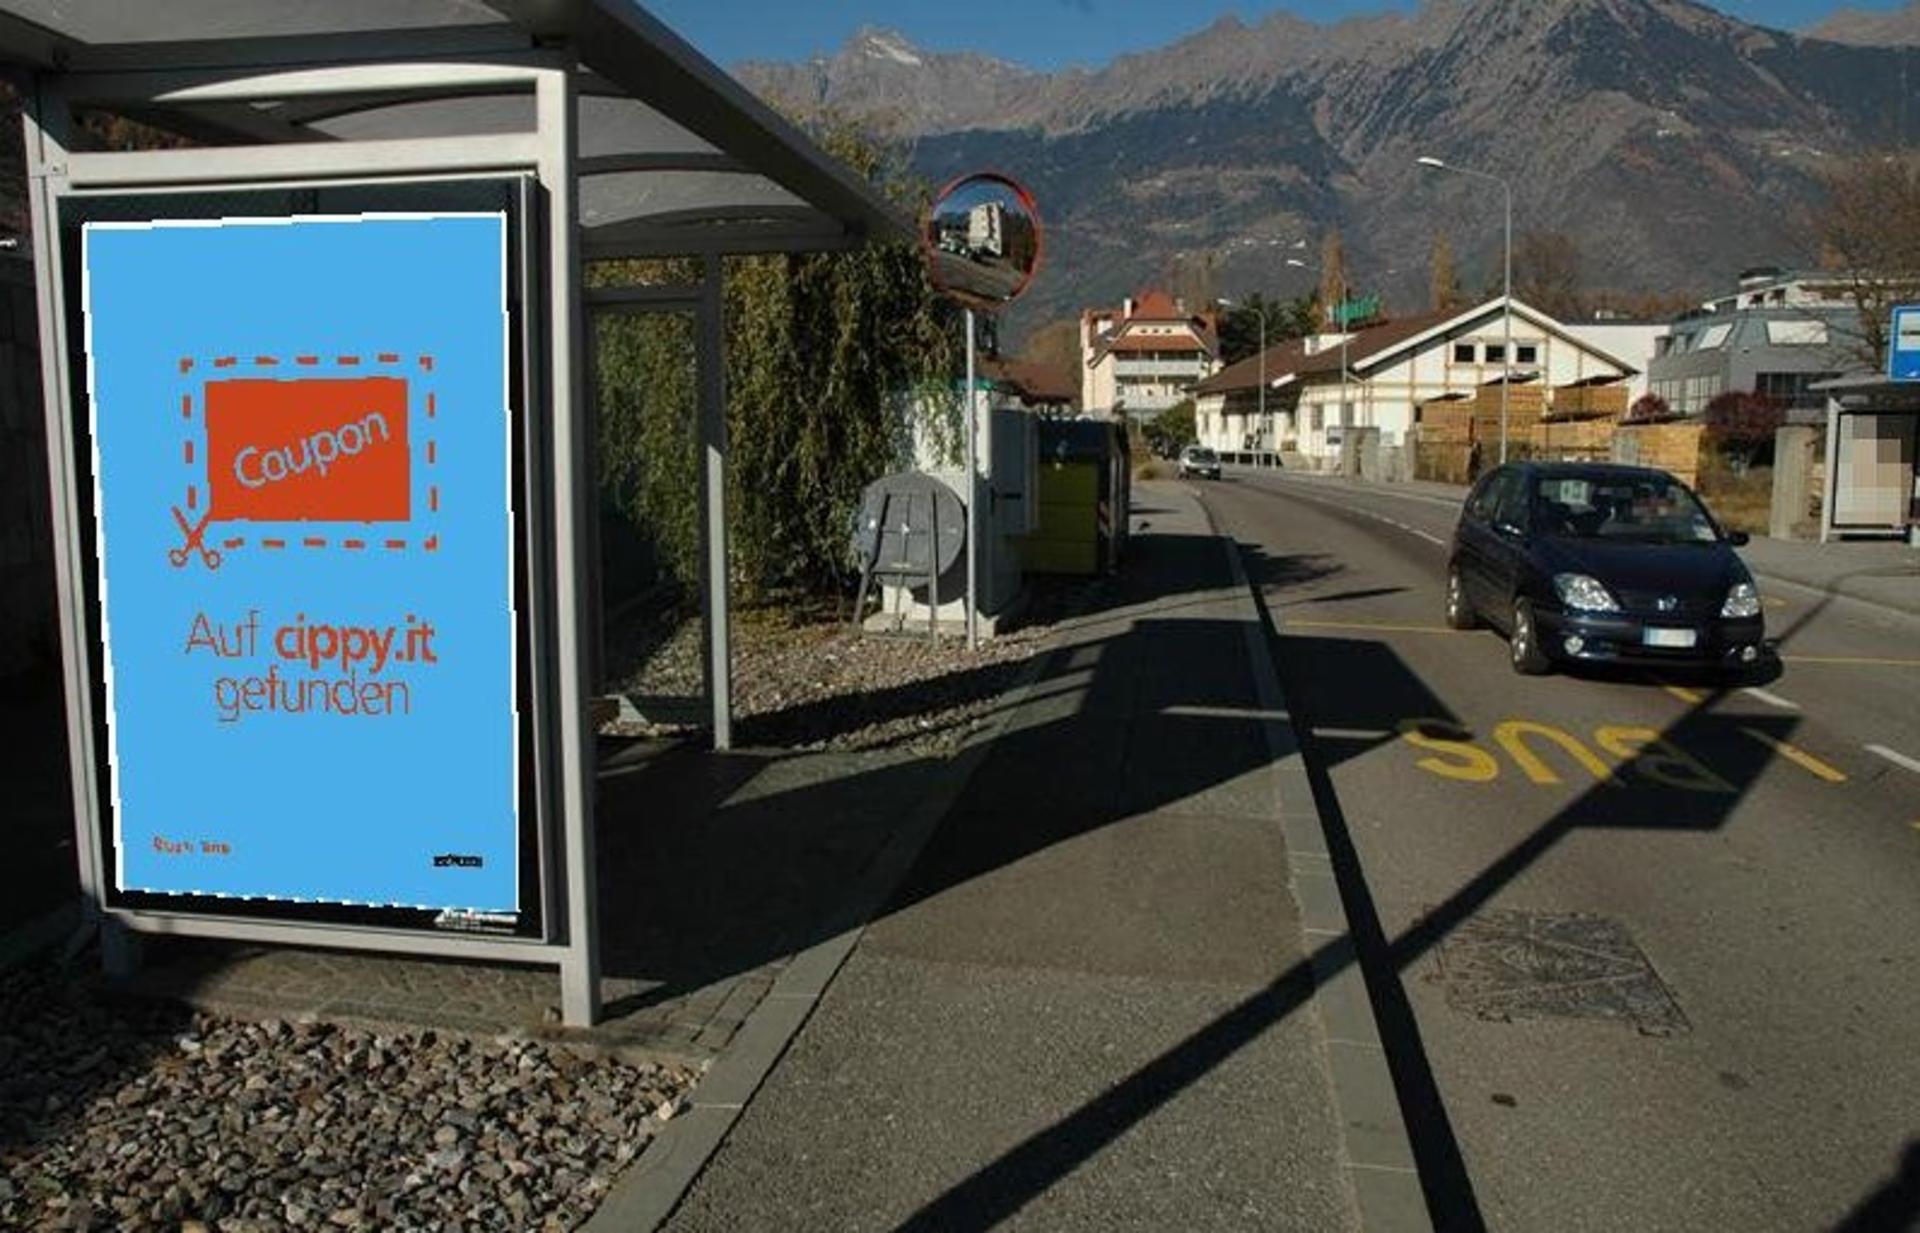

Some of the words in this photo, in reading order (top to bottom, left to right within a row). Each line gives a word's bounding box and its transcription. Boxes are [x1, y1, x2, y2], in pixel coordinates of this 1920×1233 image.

[233, 410, 389, 489] Coupon
[185, 609, 259, 659] Auf
[273, 612, 438, 674] cippy.it
[215, 664, 411, 722] gefunden
[1400, 717, 1738, 793] BUS
